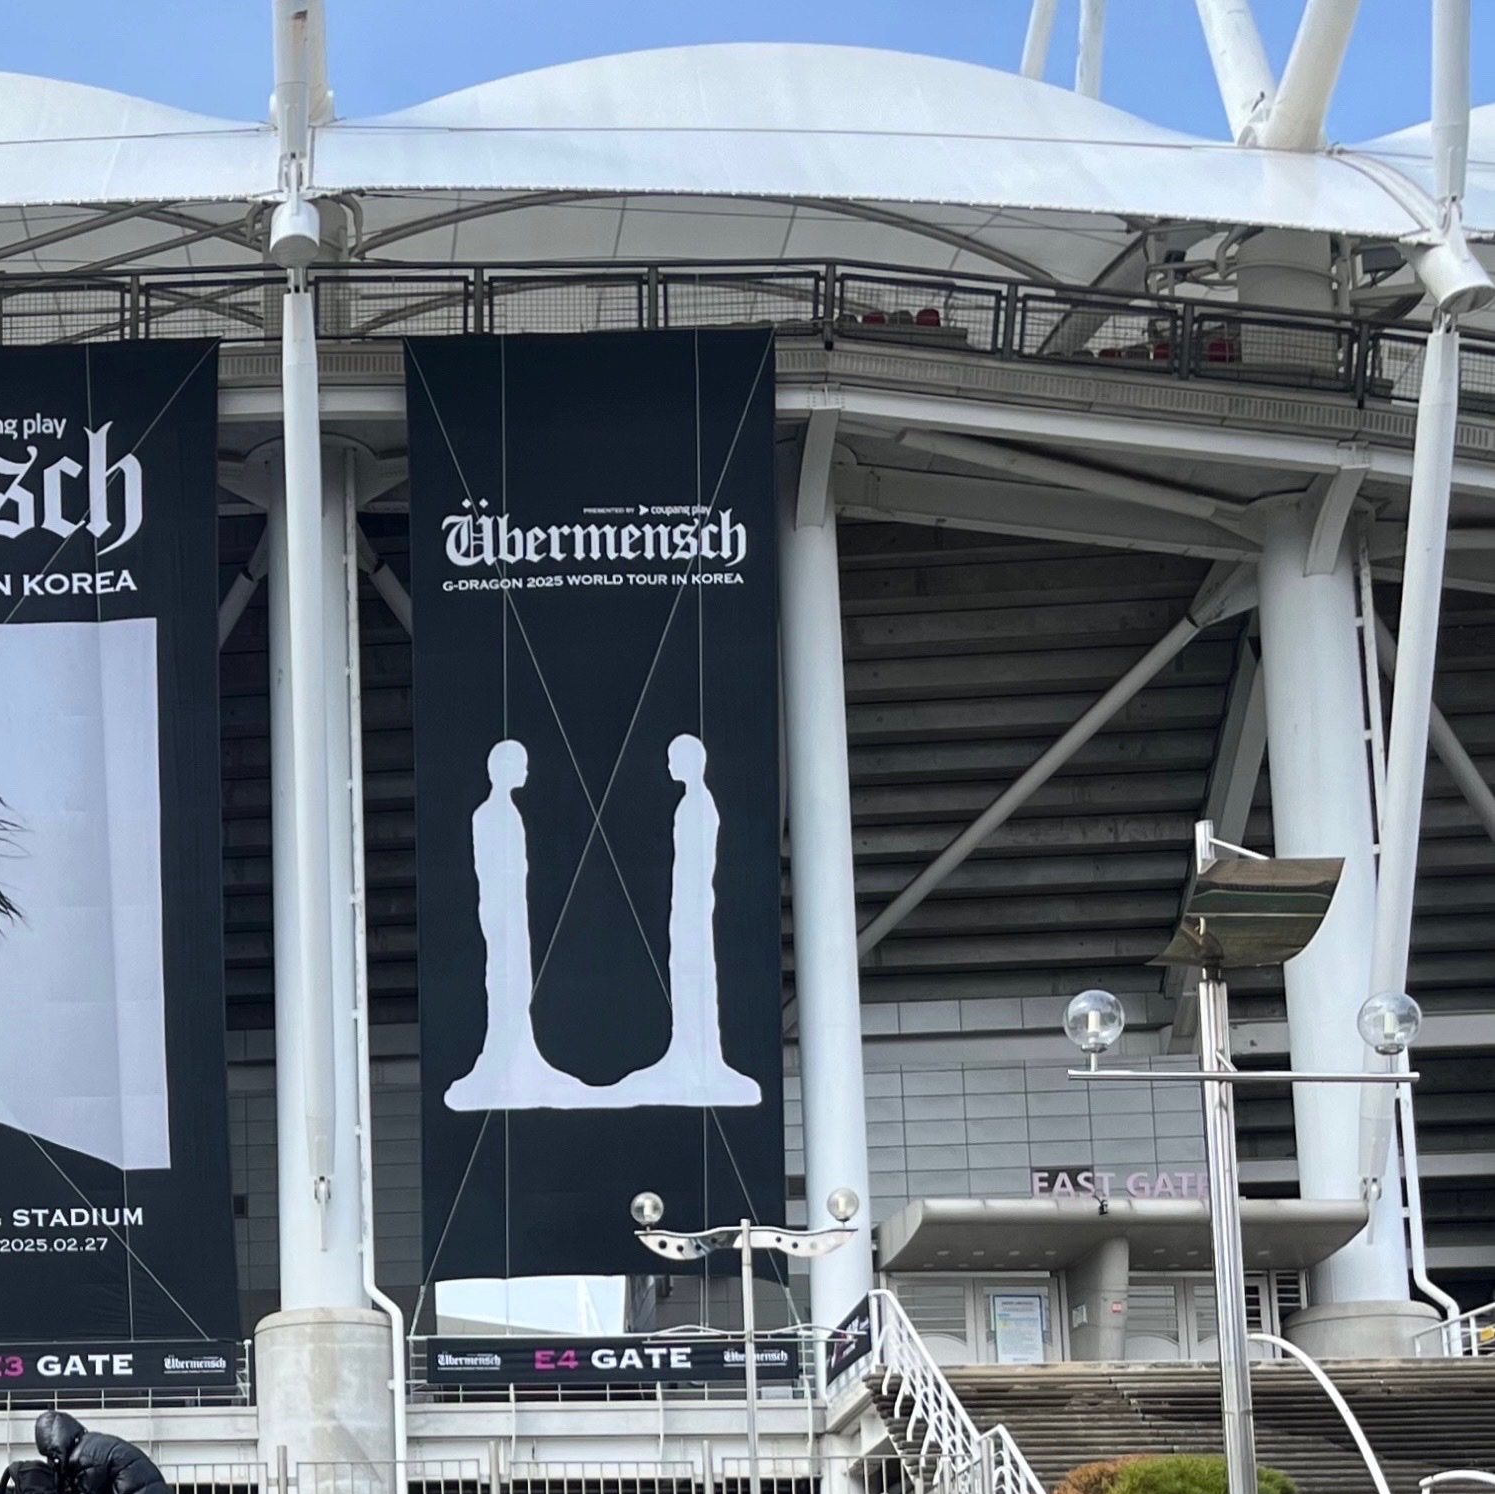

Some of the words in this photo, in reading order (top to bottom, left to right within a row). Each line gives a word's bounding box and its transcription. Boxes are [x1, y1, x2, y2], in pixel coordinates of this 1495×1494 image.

[22, 413, 67, 437] play
[650, 504, 690, 517] coupang
[691, 503, 712, 516] play
[441, 498, 747, 567] Übermensch
[22, 570, 138, 596] KOREA
[442, 578, 523, 591] G-DRAGON
[526, 575, 563, 587] 2025
[566, 574, 624, 586] WORLD
[626, 574, 668, 585] TOUR
[671, 574, 687, 585] IN
[691, 573, 745, 585] KOREA
[1032, 1172, 1116, 1198] EAST
[12, 1206, 144, 1228] STADIUM
[0, 1236, 108, 1253] 2025.02.27
[36, 1354, 133, 1376] GATE
[534, 1350, 578, 1369] E4
[591, 1347, 692, 1369] GATE
